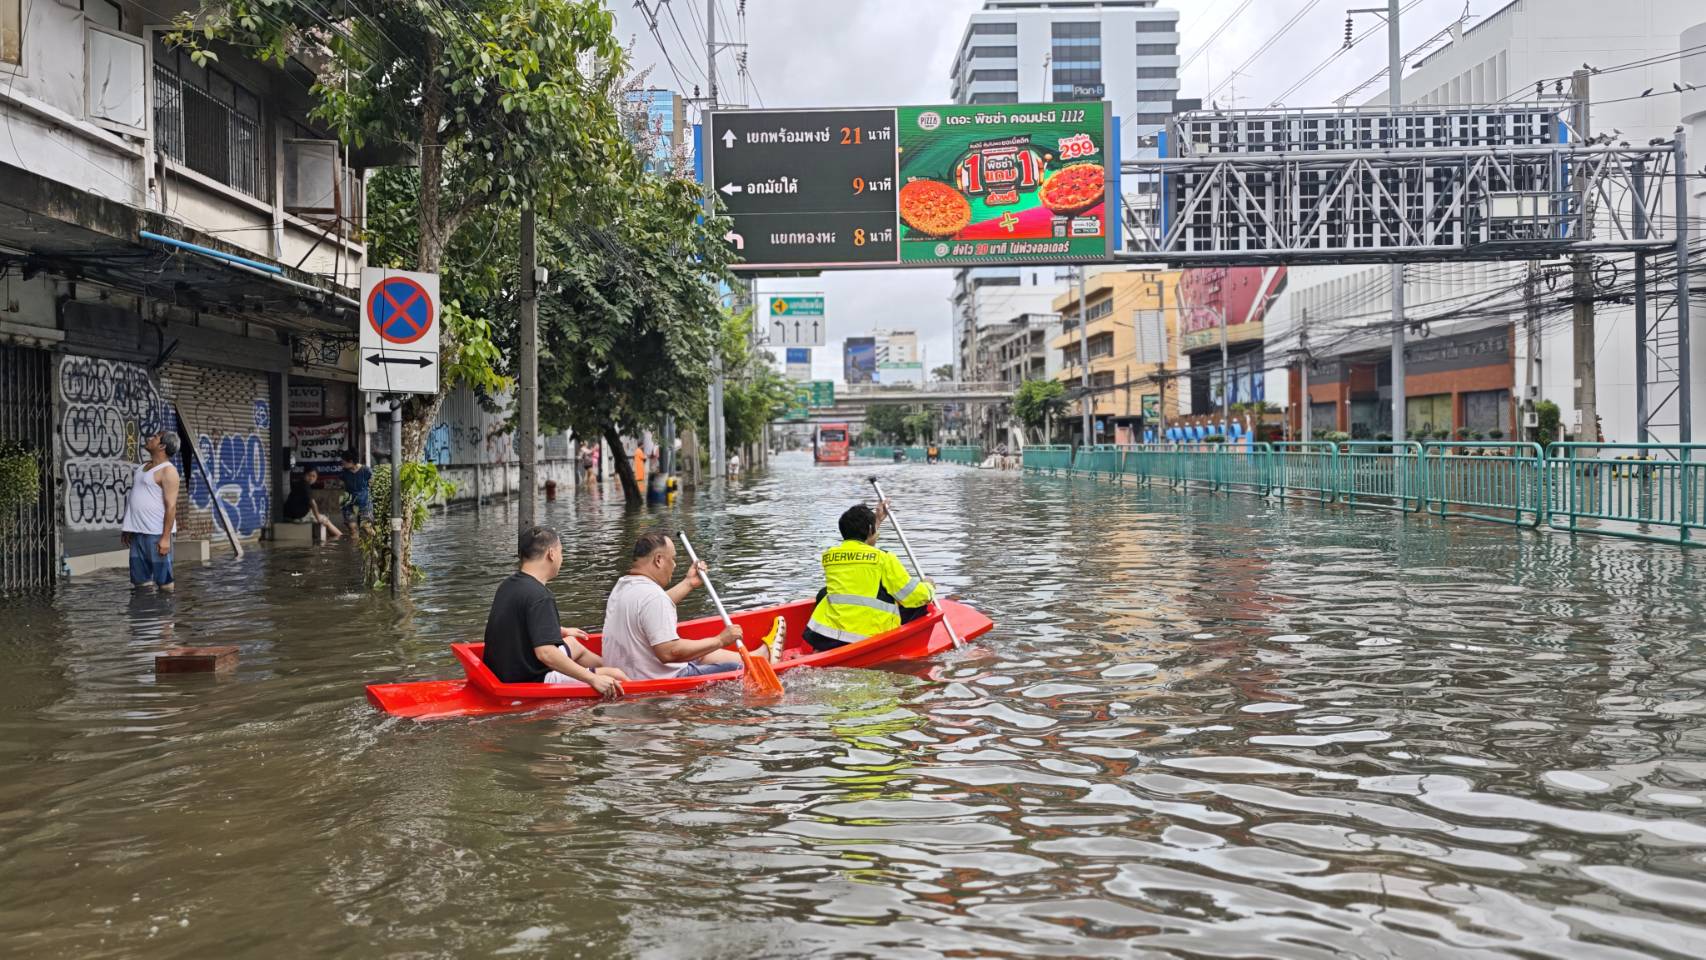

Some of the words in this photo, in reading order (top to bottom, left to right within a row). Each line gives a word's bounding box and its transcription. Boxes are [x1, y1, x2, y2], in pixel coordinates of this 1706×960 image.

[1075, 86, 1095, 95] Plan
[920, 116, 938, 125] PIZZA
[946, 115, 971, 125] เดอะ
[1010, 110, 1056, 123] คอมปะนี
[1060, 110, 1085, 123] 1112
[840, 126, 862, 145] 21
[868, 126, 891, 141] นาที
[964, 153, 983, 192] 1
[1017, 149, 1035, 186] 1
[852, 175, 865, 195] 9
[869, 178, 892, 192] นาที
[853, 228, 866, 246] 8
[869, 229, 893, 243] นาที
[288, 389, 320, 397] OLVO
[822, 552, 877, 563] FEUERWEHR
